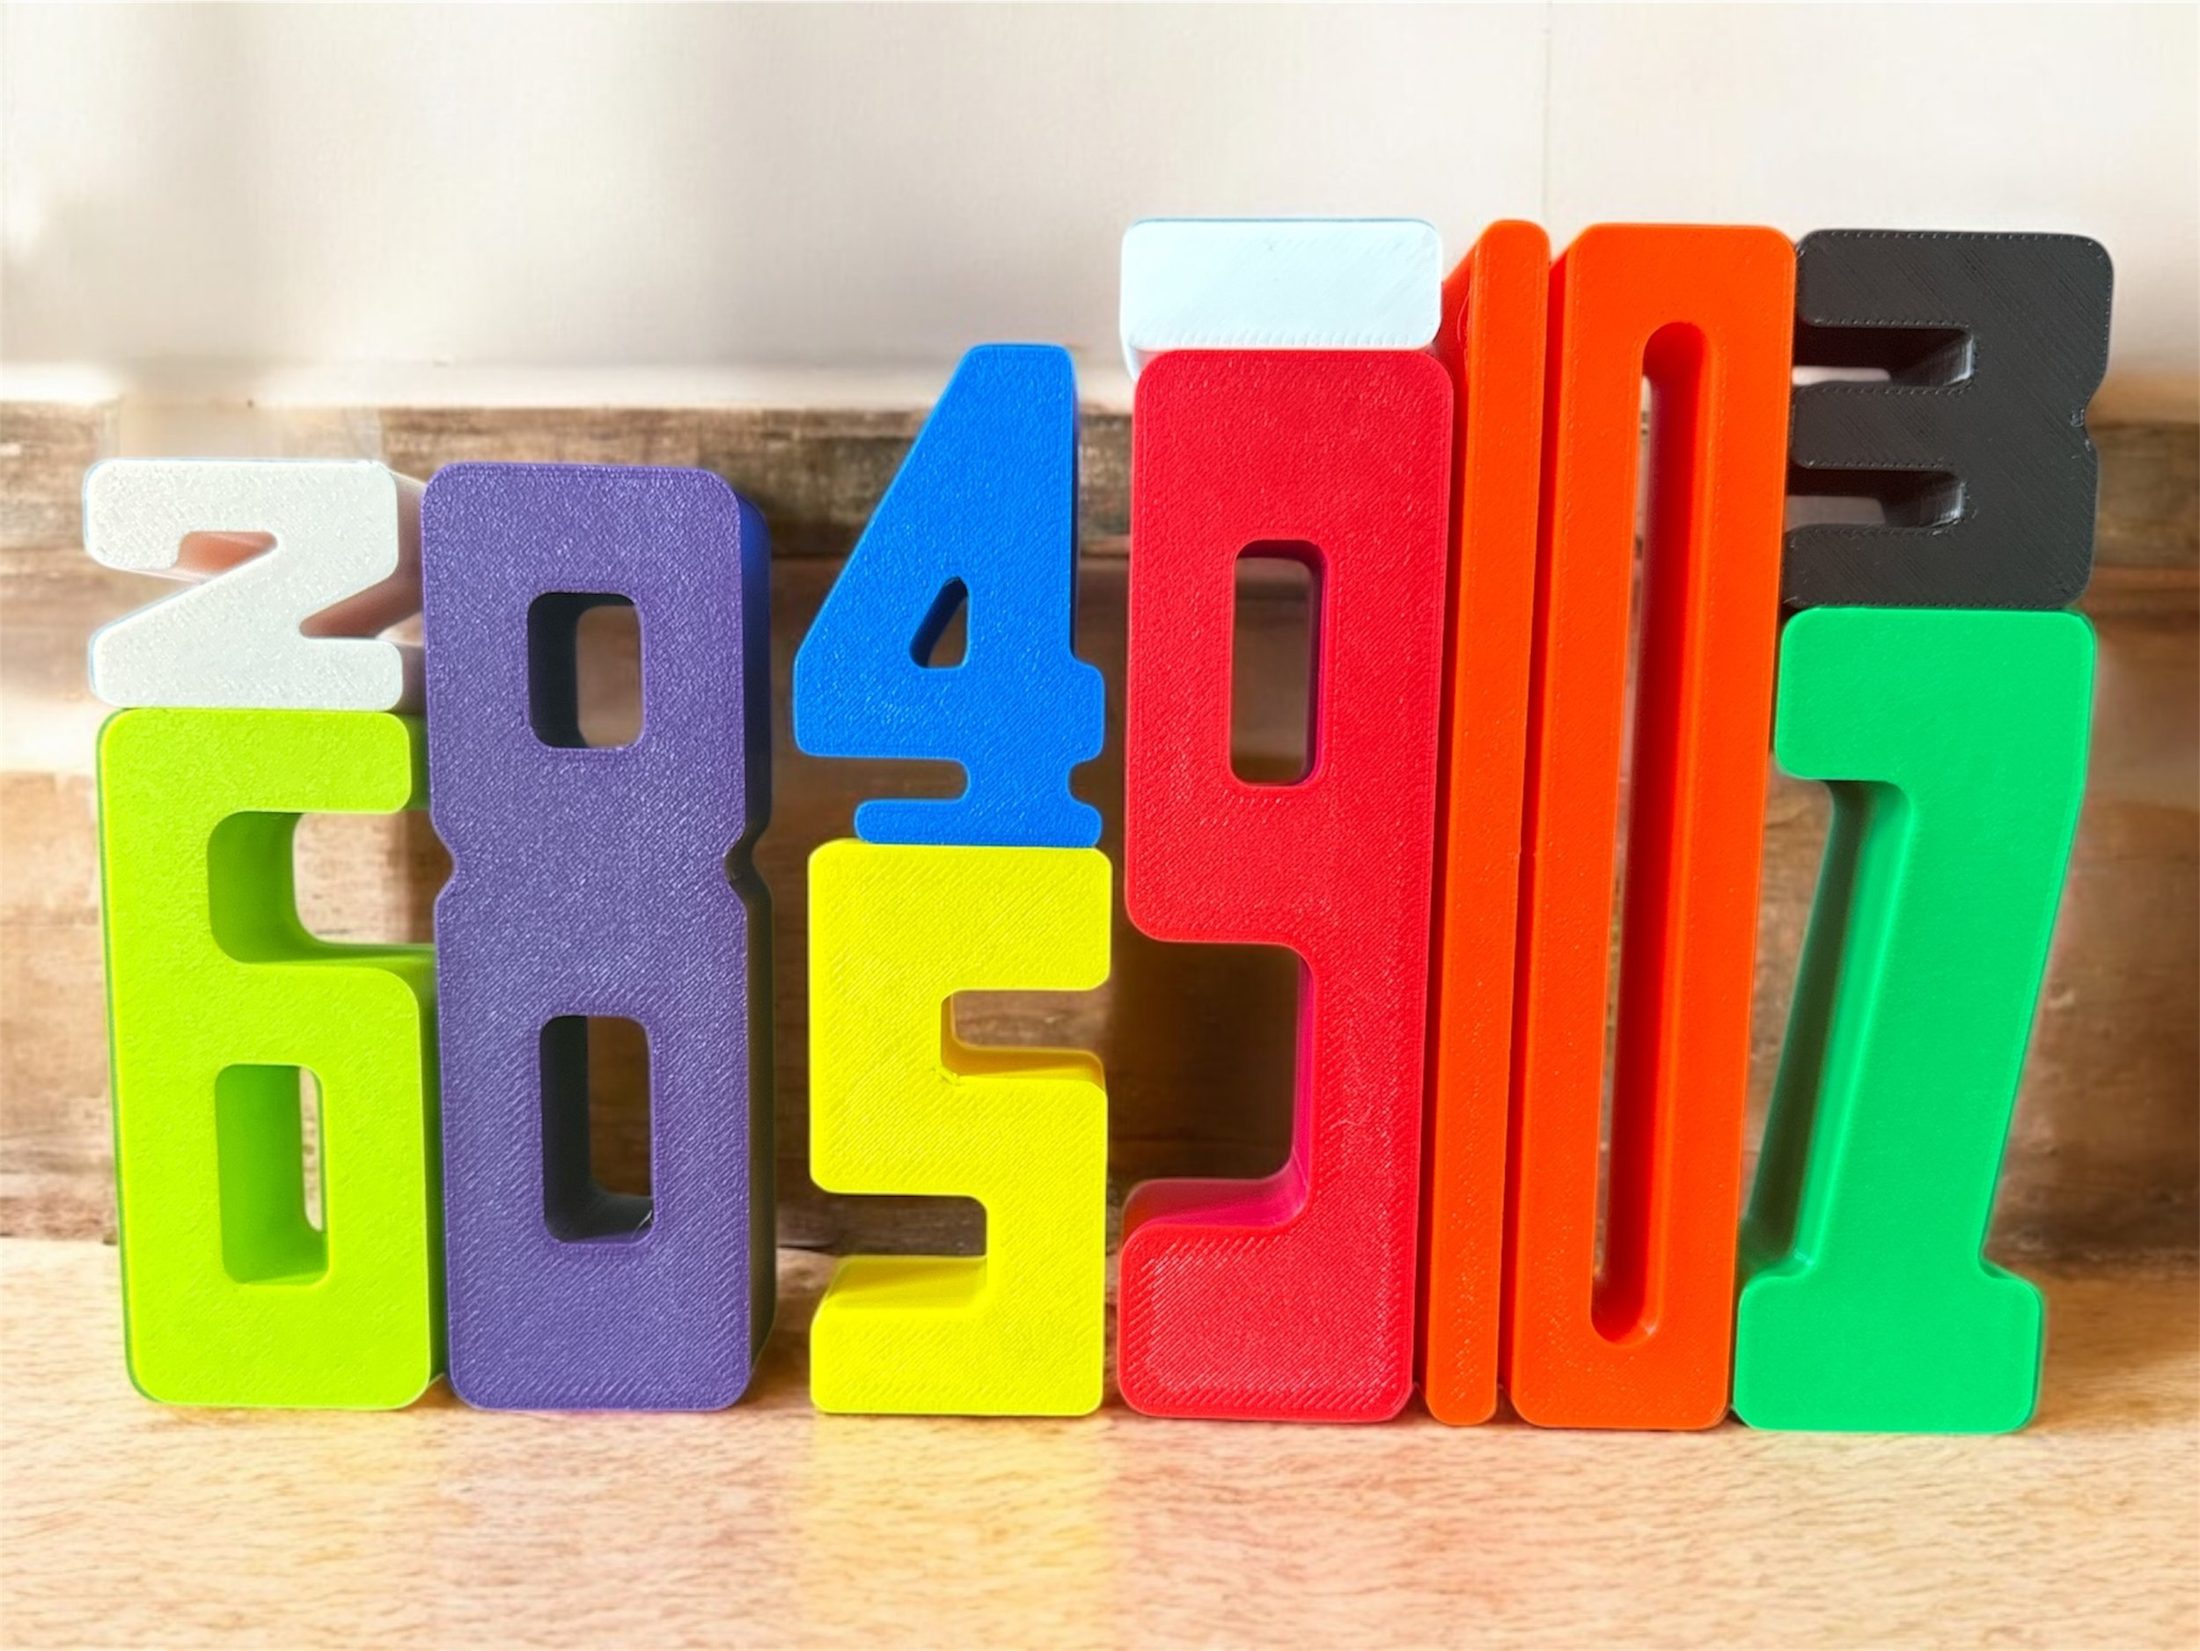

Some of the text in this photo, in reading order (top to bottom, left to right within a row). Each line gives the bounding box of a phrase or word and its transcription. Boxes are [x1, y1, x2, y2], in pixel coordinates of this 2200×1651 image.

[84, 457, 403, 712] 2
[793, 343, 1105, 848] 4
[1783, 228, 2114, 611] 3
[97, 707, 432, 1410] 6
[421, 462, 752, 1411] 8
[808, 838, 1112, 1416] 5
[1118, 349, 1454, 1424] 9
[1733, 606, 2097, 1434] 7
